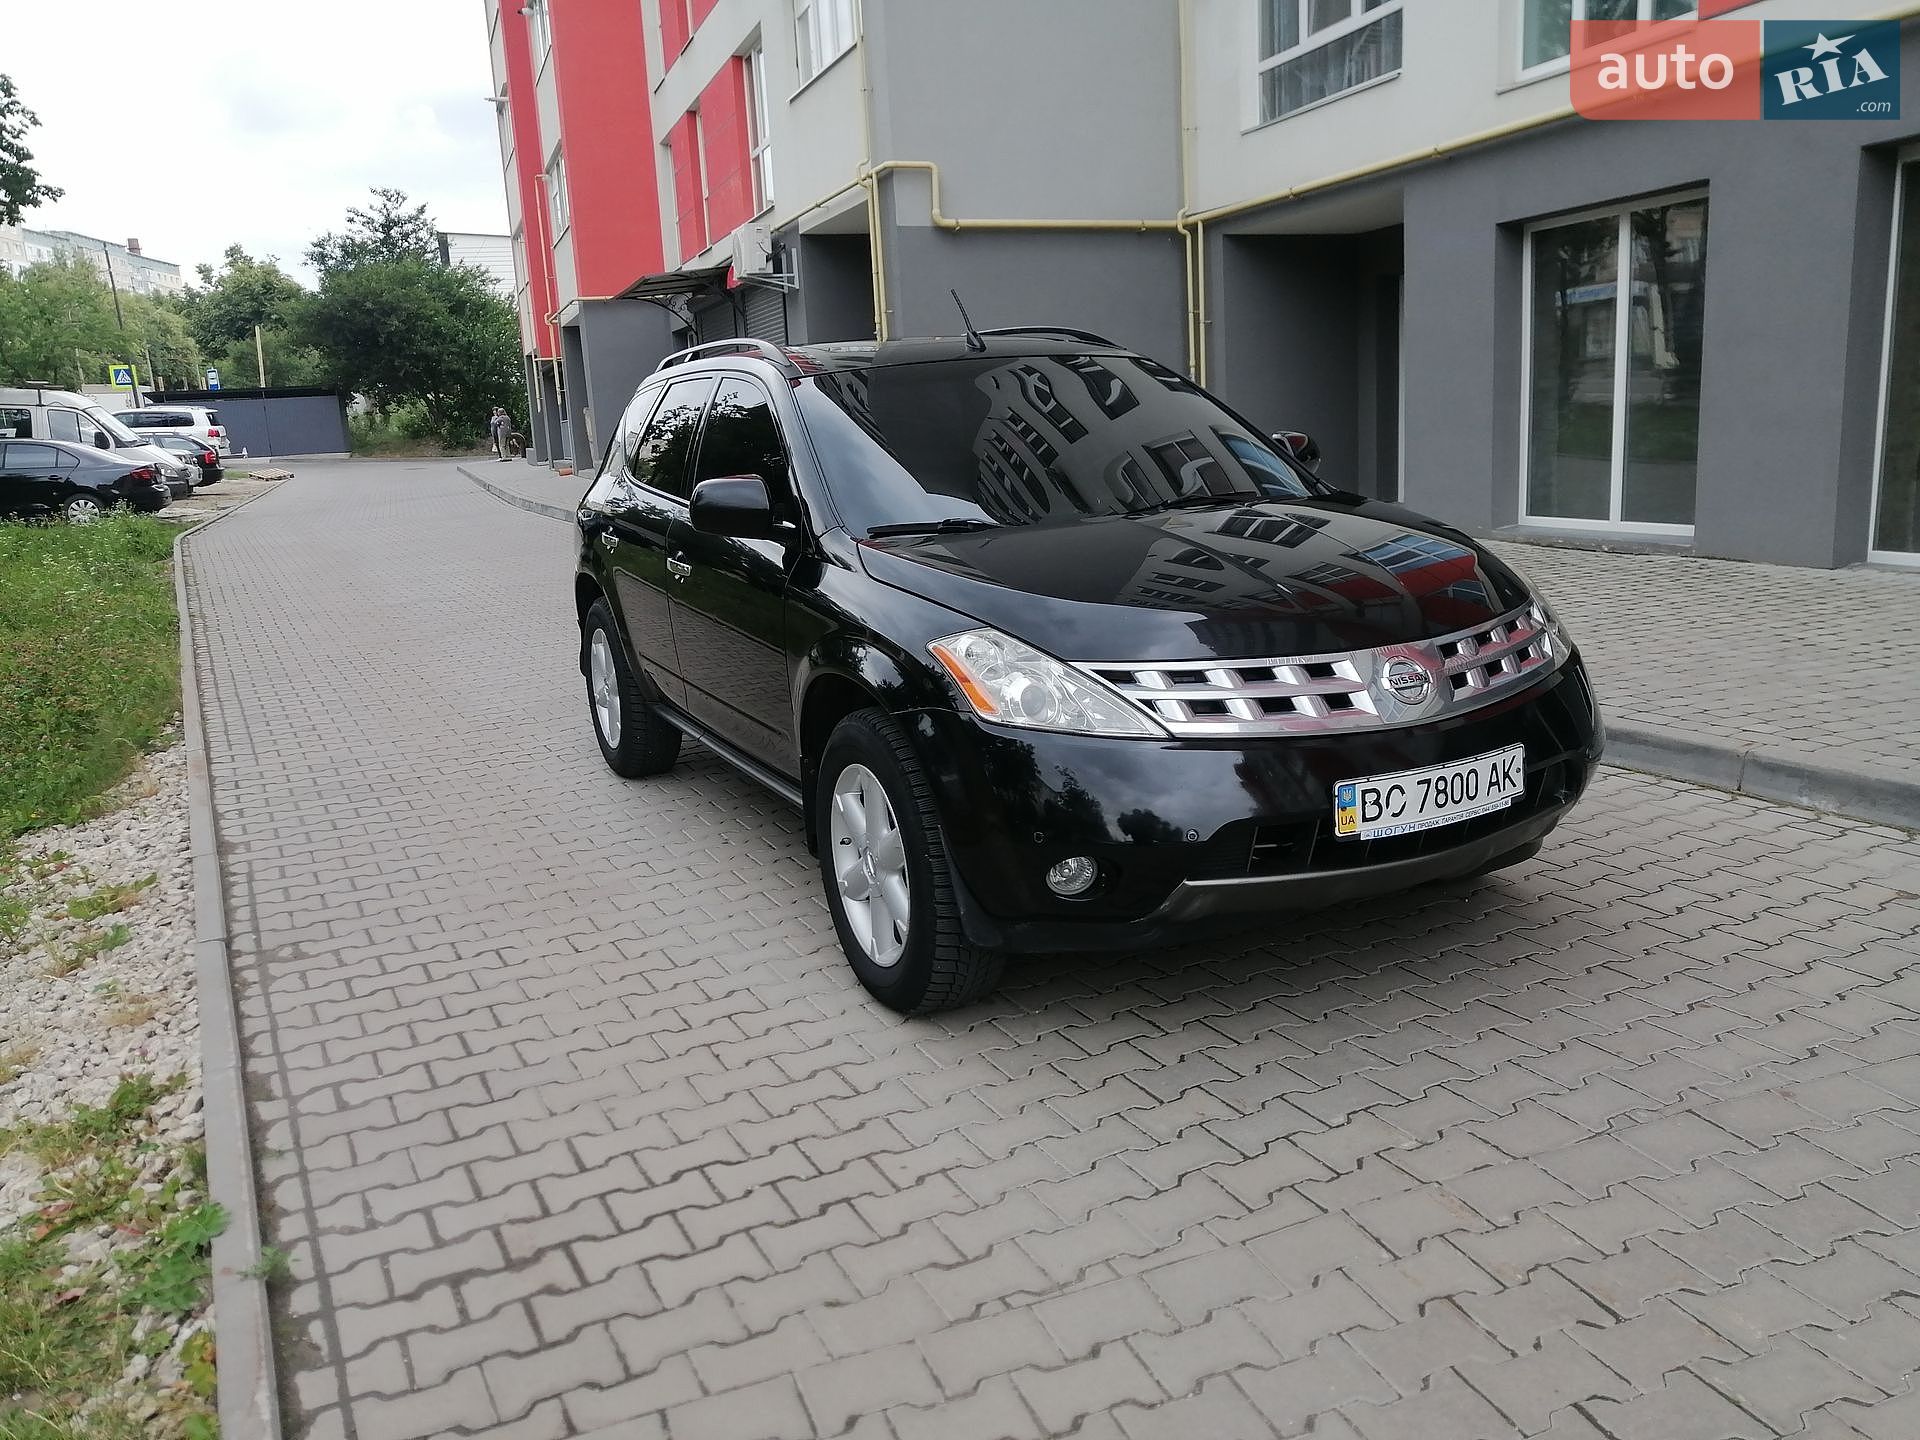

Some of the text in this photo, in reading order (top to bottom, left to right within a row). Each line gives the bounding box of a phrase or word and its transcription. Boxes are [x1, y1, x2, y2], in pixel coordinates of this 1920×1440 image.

[1360, 754, 1517, 823] BC 7800 AK
[1340, 816, 1356, 827] UA
[1373, 823, 1416, 838] ШОГУН
